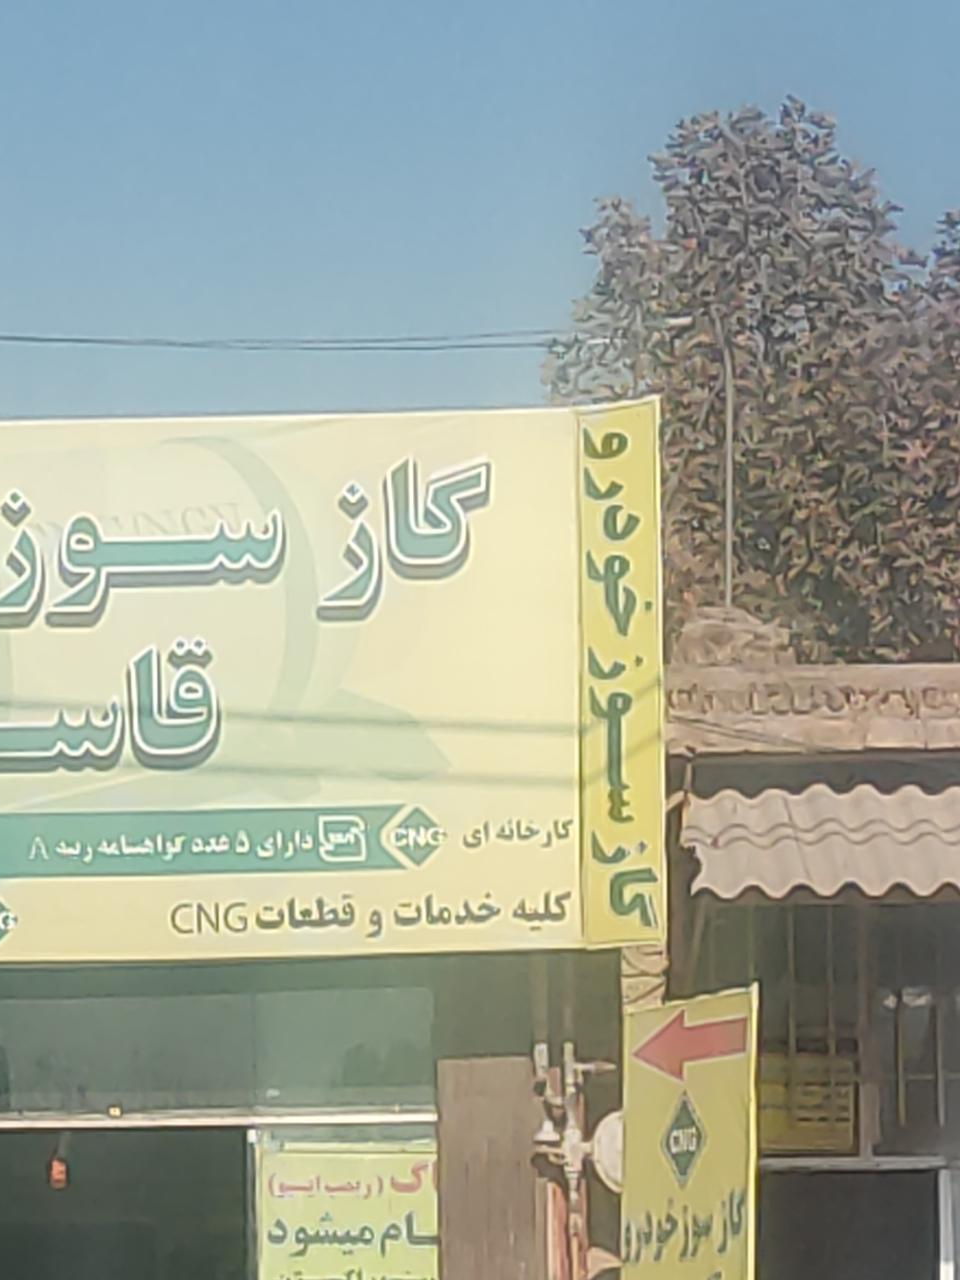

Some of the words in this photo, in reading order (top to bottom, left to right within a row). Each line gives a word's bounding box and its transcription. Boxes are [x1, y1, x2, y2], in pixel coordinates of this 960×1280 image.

[317, 453, 493, 623] گاز
[583, 427, 653, 637] خودرو
[588, 645, 644, 824] سوز
[254, 829, 313, 861] دارای
[390, 825, 446, 850] CNG
[170, 901, 248, 936] CNG
[253, 894, 357, 930] قطعات
[365, 903, 384, 938] و
[393, 891, 501, 926] خدمات
[512, 890, 572, 932] کلیه
[669, 1127, 698, 1154] CNG
[267, 1211, 374, 1258] میشود
[717, 1188, 745, 1254] گاز
